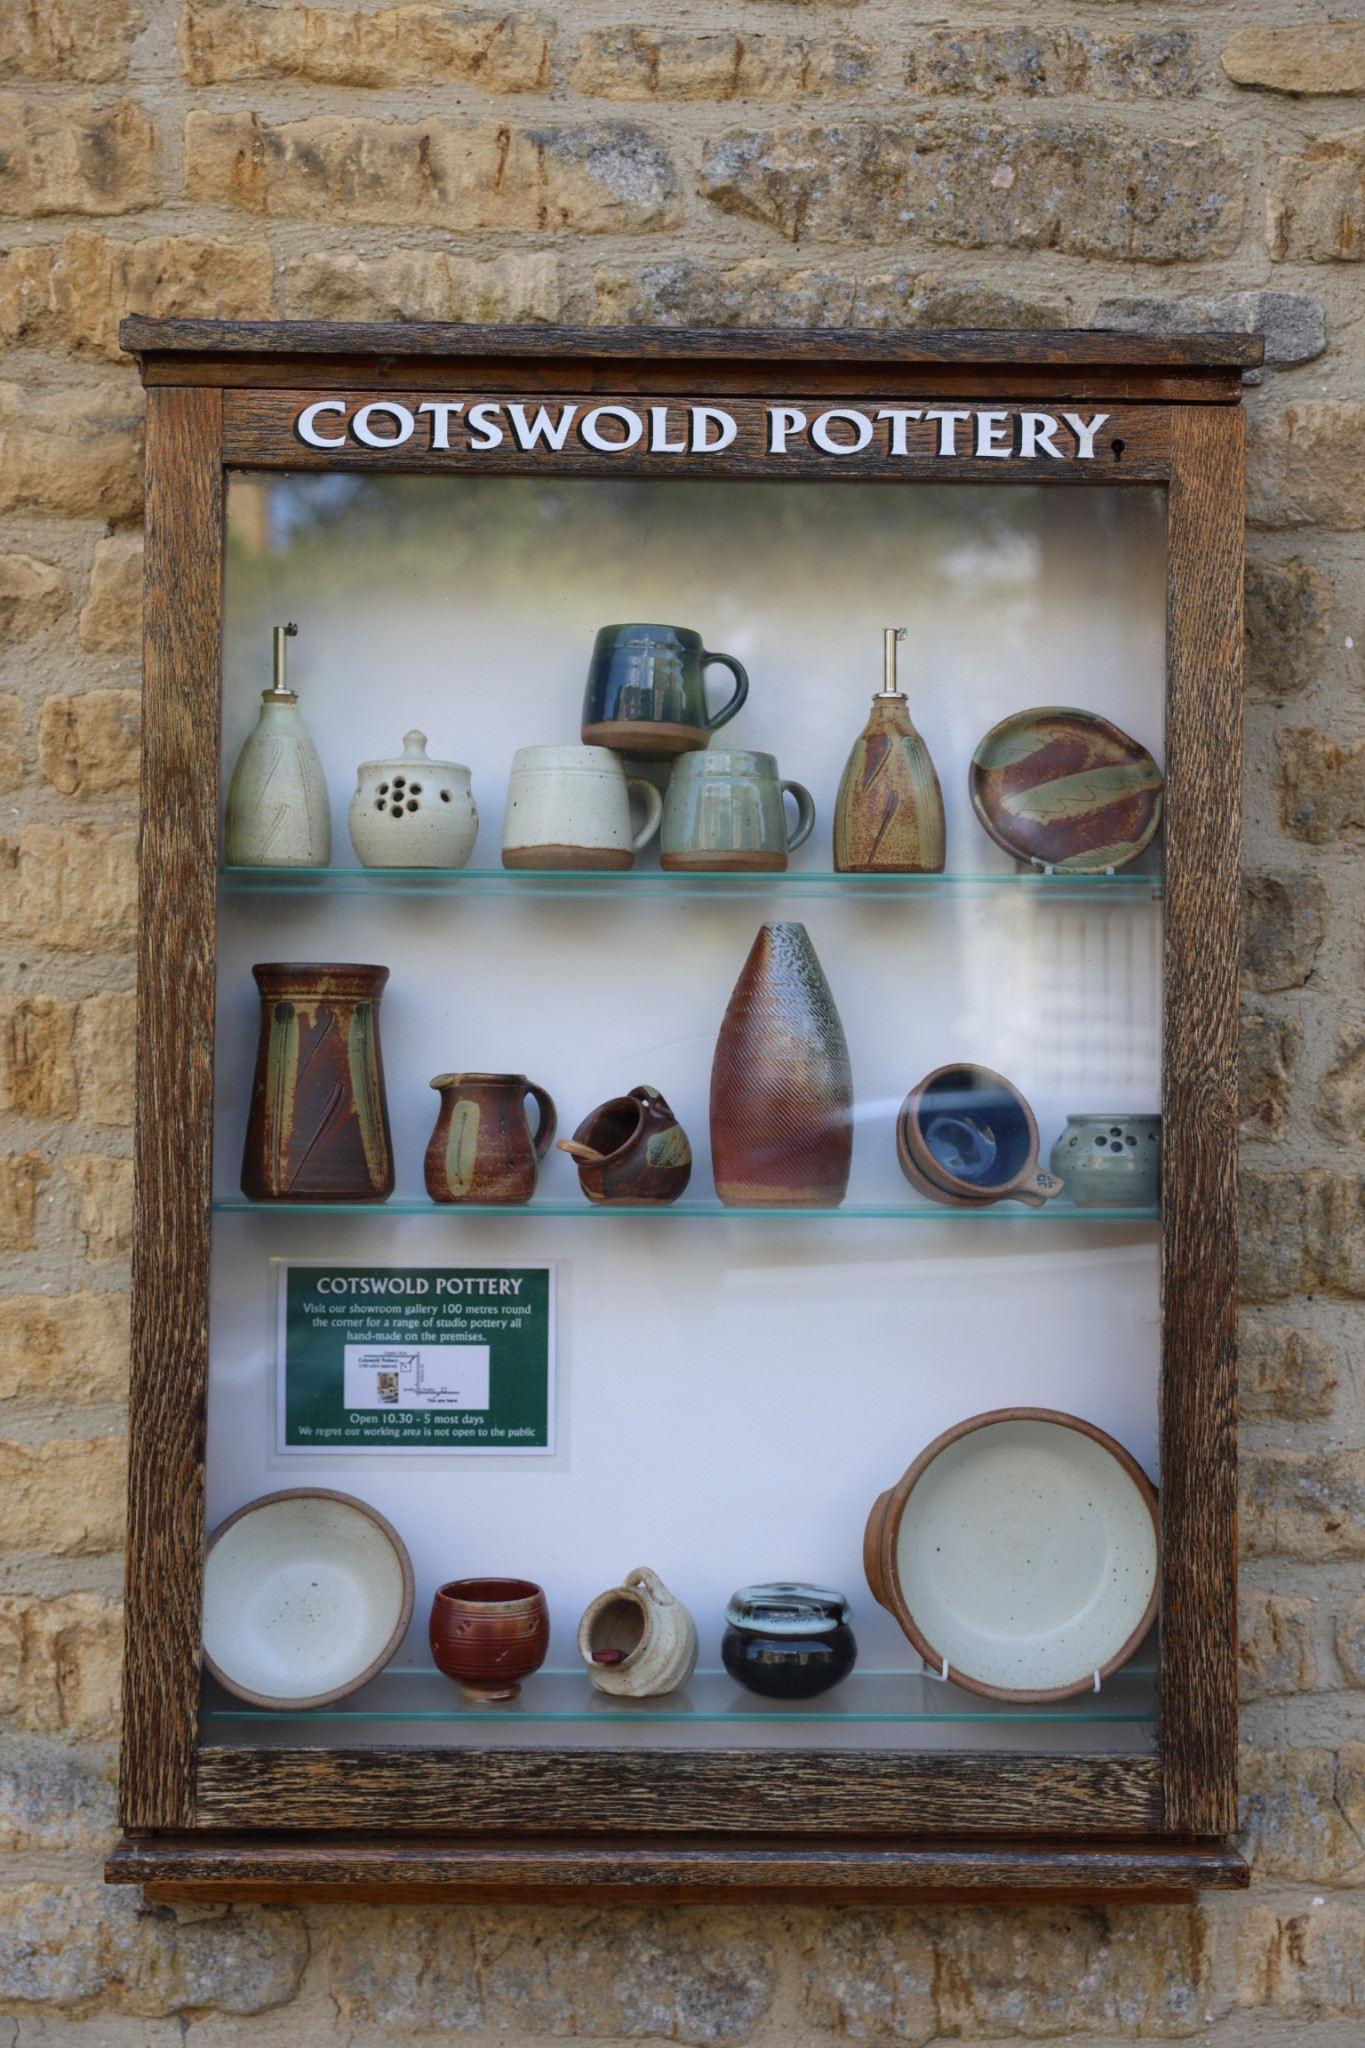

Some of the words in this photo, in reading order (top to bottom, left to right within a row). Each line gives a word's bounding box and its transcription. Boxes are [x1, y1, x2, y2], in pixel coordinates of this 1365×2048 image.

[298, 400, 738, 455] COTSWOLD
[768, 406, 1111, 460] POTTERY
[316, 1277, 429, 1295] COTSWOLD
[436, 1277, 523, 1295] POTTERY
[303, 1303, 326, 1314] Visit
[328, 1306, 346, 1314] our
[349, 1303, 402, 1314] showroom
[404, 1303, 438, 1316] gallery
[442, 1303, 462, 1314] 100
[465, 1305, 498, 1315] metres
[501, 1303, 532, 1316] round
[312, 1317, 328, 1327] the
[331, 1319, 364, 1328] corner
[366, 1316, 381, 1328] for
[383, 1320, 390, 1328] a
[392, 1319, 420, 1330] range
[422, 1316, 433, 1328] of
[436, 1317, 468, 1329] studio
[470, 1319, 507, 1330] pottery
[510, 1317, 522, 1329] all
[346, 1330, 402, 1342] hand-made
[405, 1332, 418, 1342] on
[420, 1330, 437, 1342] the
[439, 1331, 487, 1343] premises.
[349, 1413, 379, 1426] Open
[382, 1413, 413, 1424] 10.30
[423, 1413, 431, 1424] 5
[434, 1414, 458, 1425] most
[461, 1413, 485, 1426] days
[298, 1426, 312, 1436] We
[315, 1427, 342, 1438] regret
[344, 1428, 360, 1436] our
[362, 1426, 401, 1438] working
[402, 1428, 421, 1437] area
[423, 1426, 432, 1437] is
[434, 1427, 450, 1437] not
[451, 1428, 476, 1439] open
[478, 1427, 489, 1437] to
[490, 1426, 505, 1438] the
[507, 1426, 536, 1439] public
